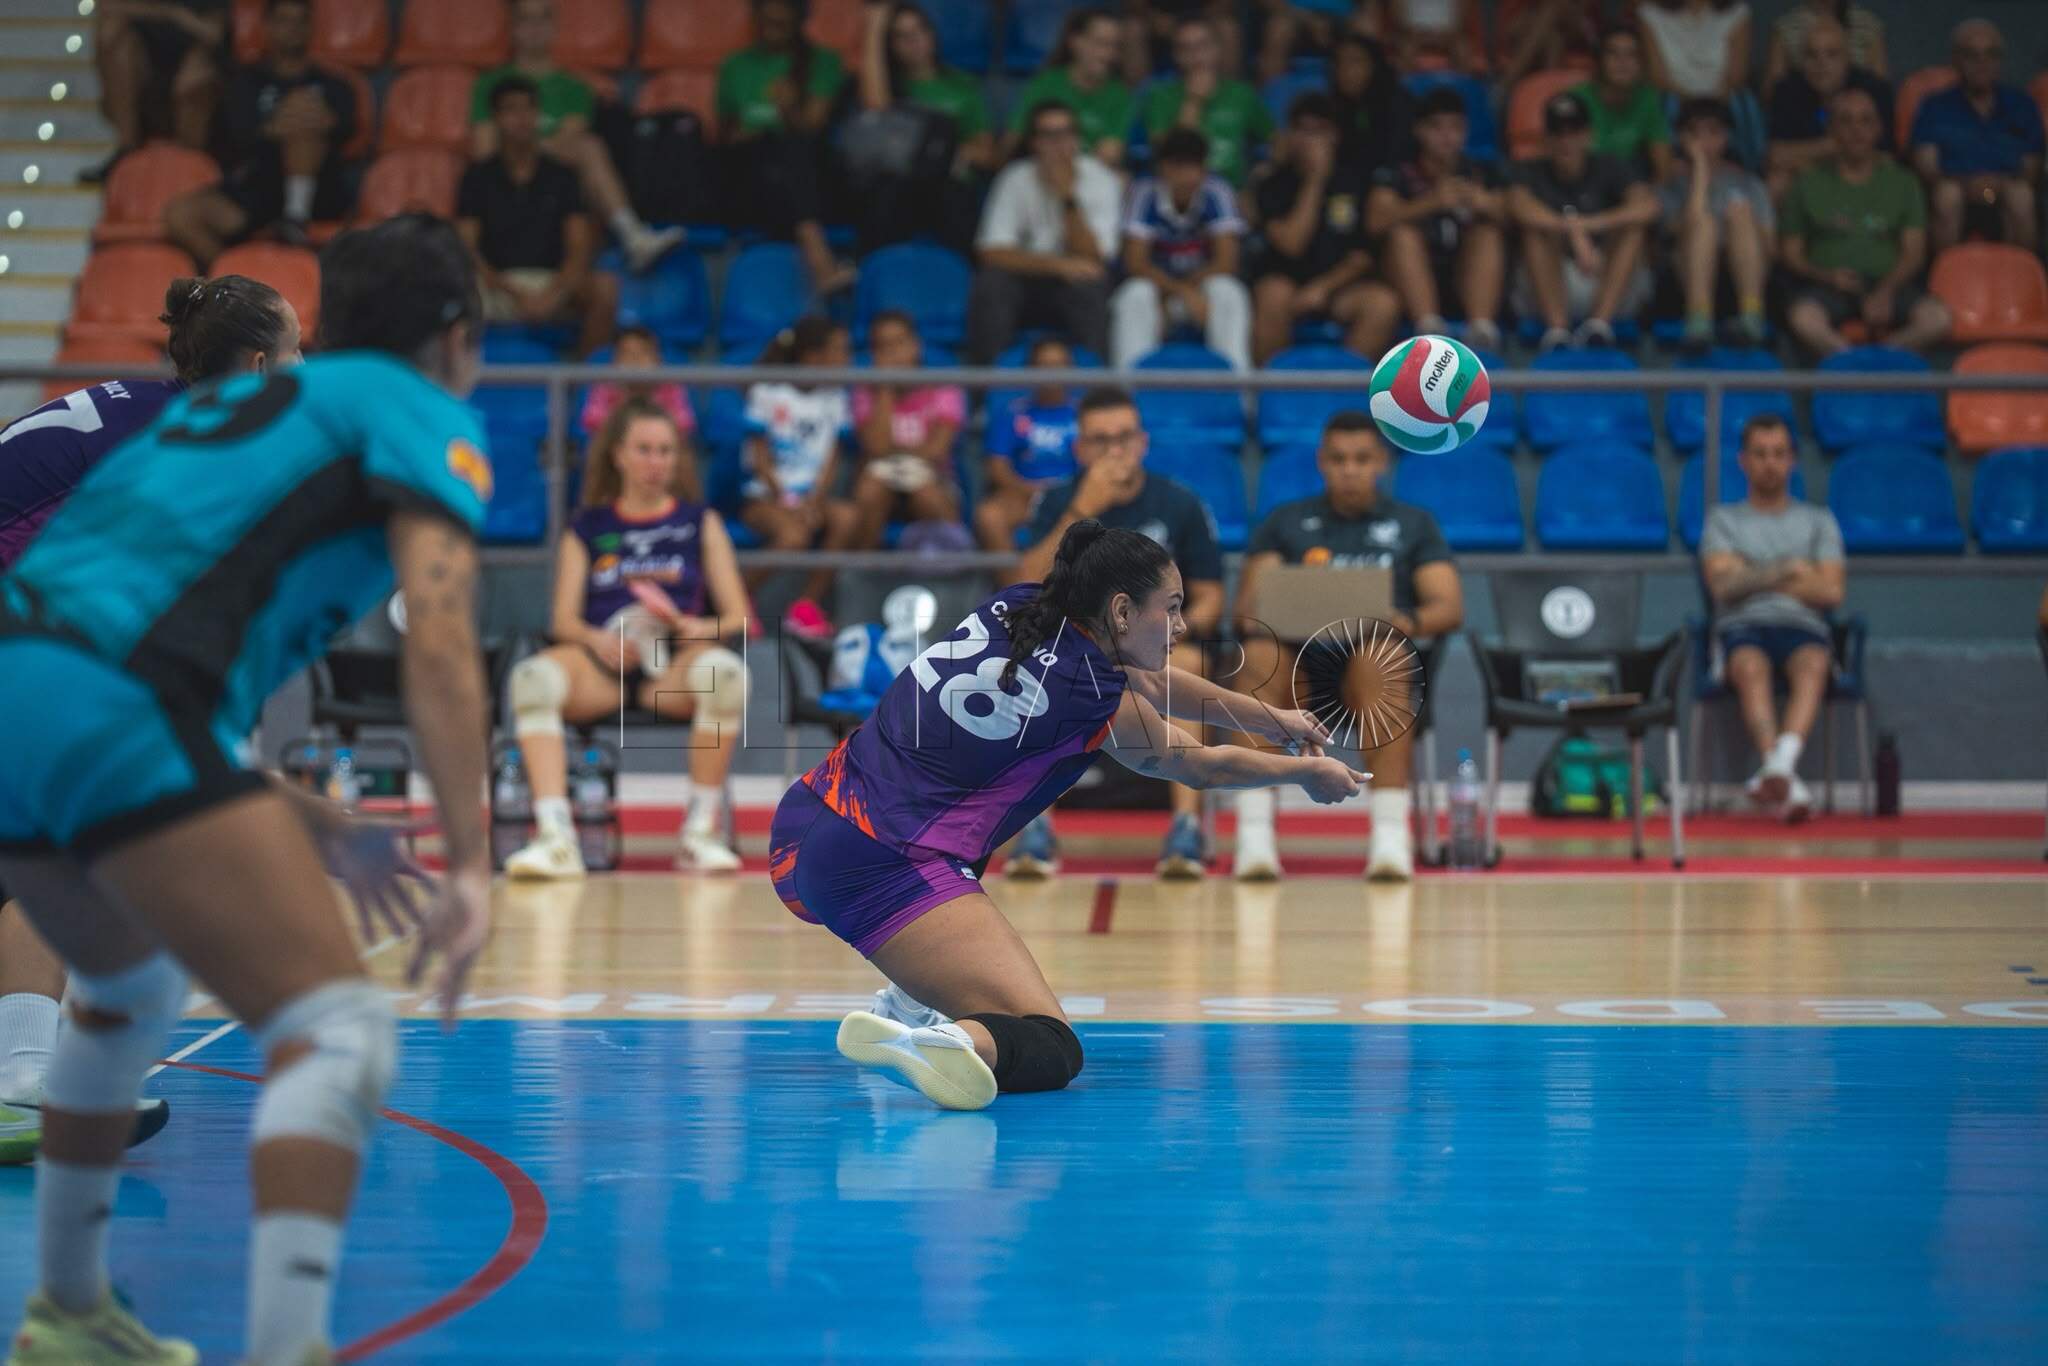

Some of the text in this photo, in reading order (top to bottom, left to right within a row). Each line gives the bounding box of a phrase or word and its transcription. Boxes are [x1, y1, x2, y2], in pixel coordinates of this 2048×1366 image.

[1425, 350, 1454, 391] molten
[909, 612, 1049, 740] 28
[1198, 996, 1727, 1018] DOS
